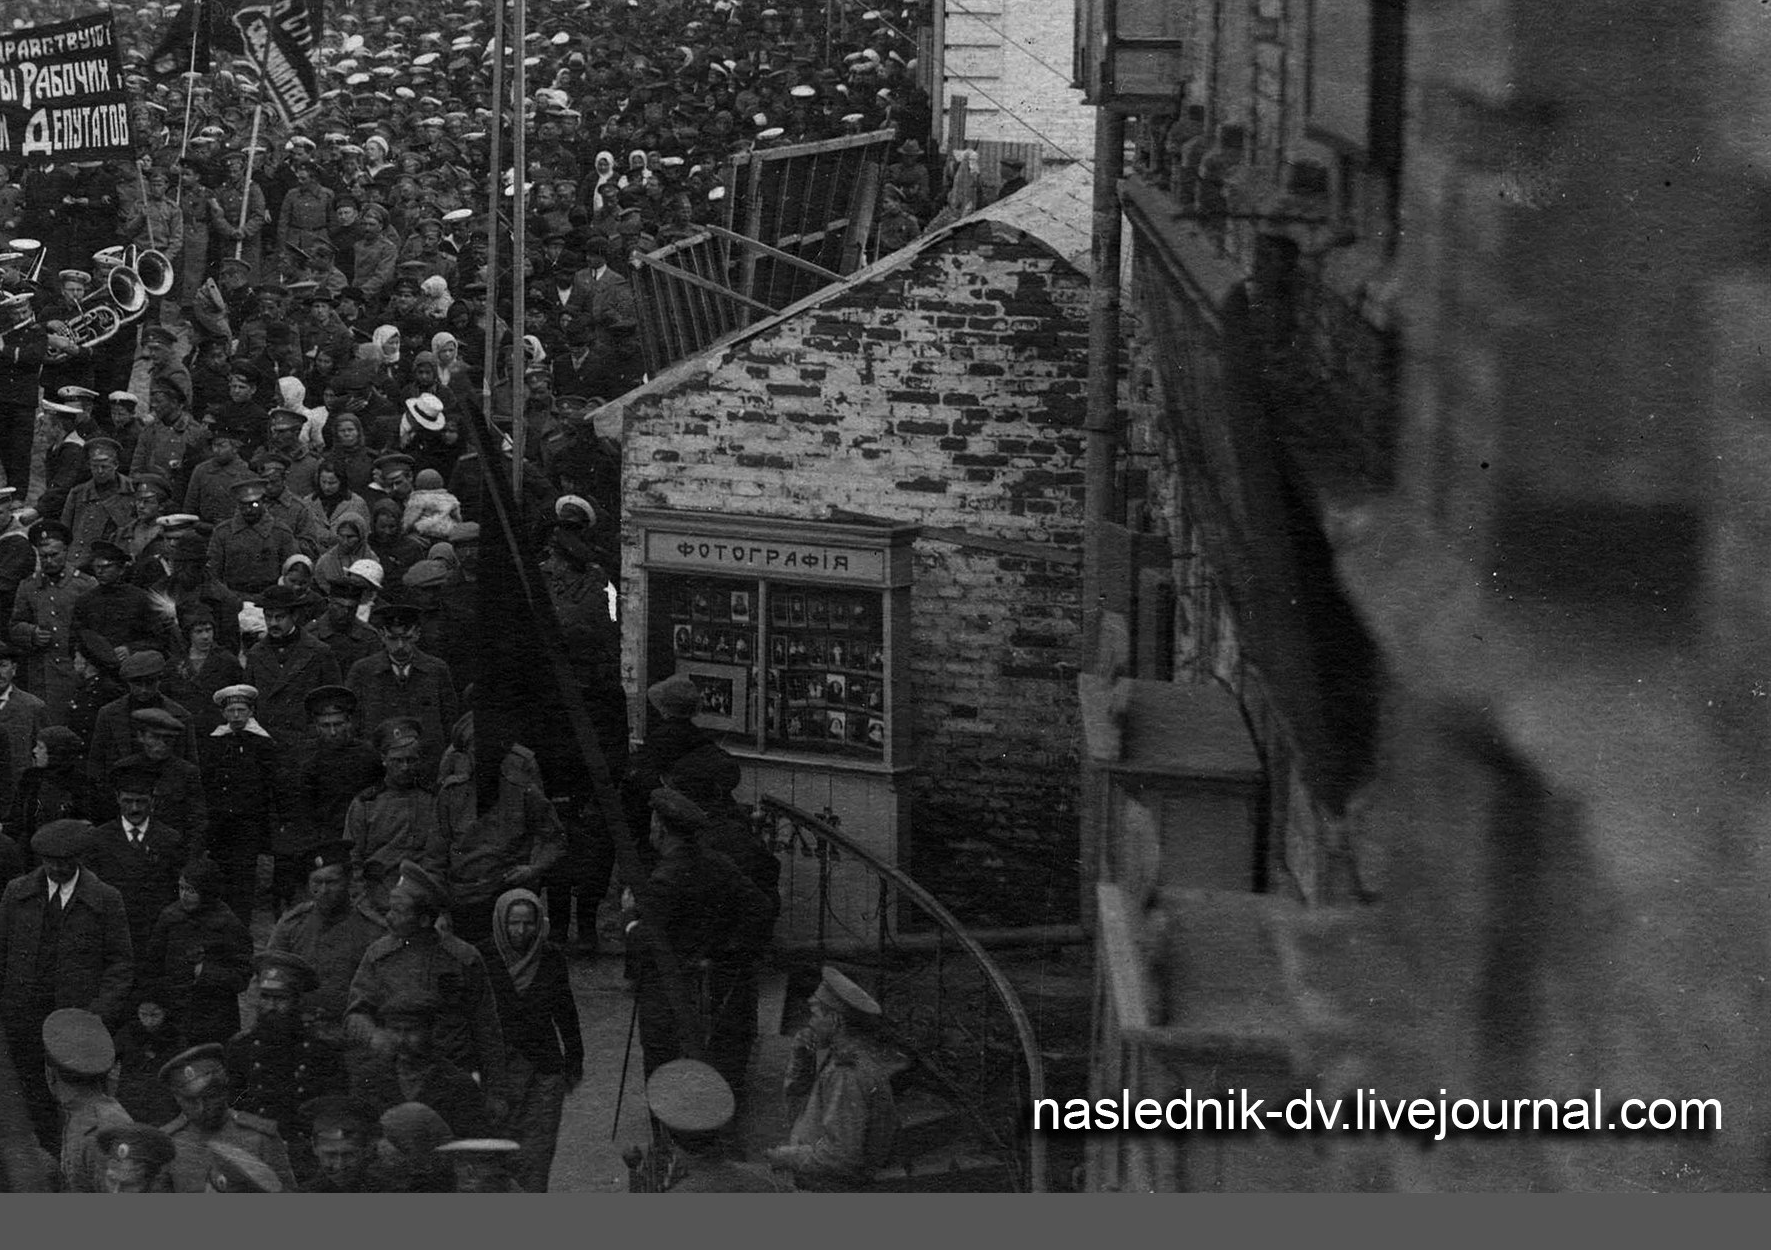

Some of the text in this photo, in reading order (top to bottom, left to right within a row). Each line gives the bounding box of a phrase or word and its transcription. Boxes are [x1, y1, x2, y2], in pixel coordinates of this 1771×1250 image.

[18, 58, 110, 111] РАБОЧИХ
[22, 103, 130, 156] ДЕПУТАТОВ
[677, 541, 849, 571] ФОТОГРАФІЯ
